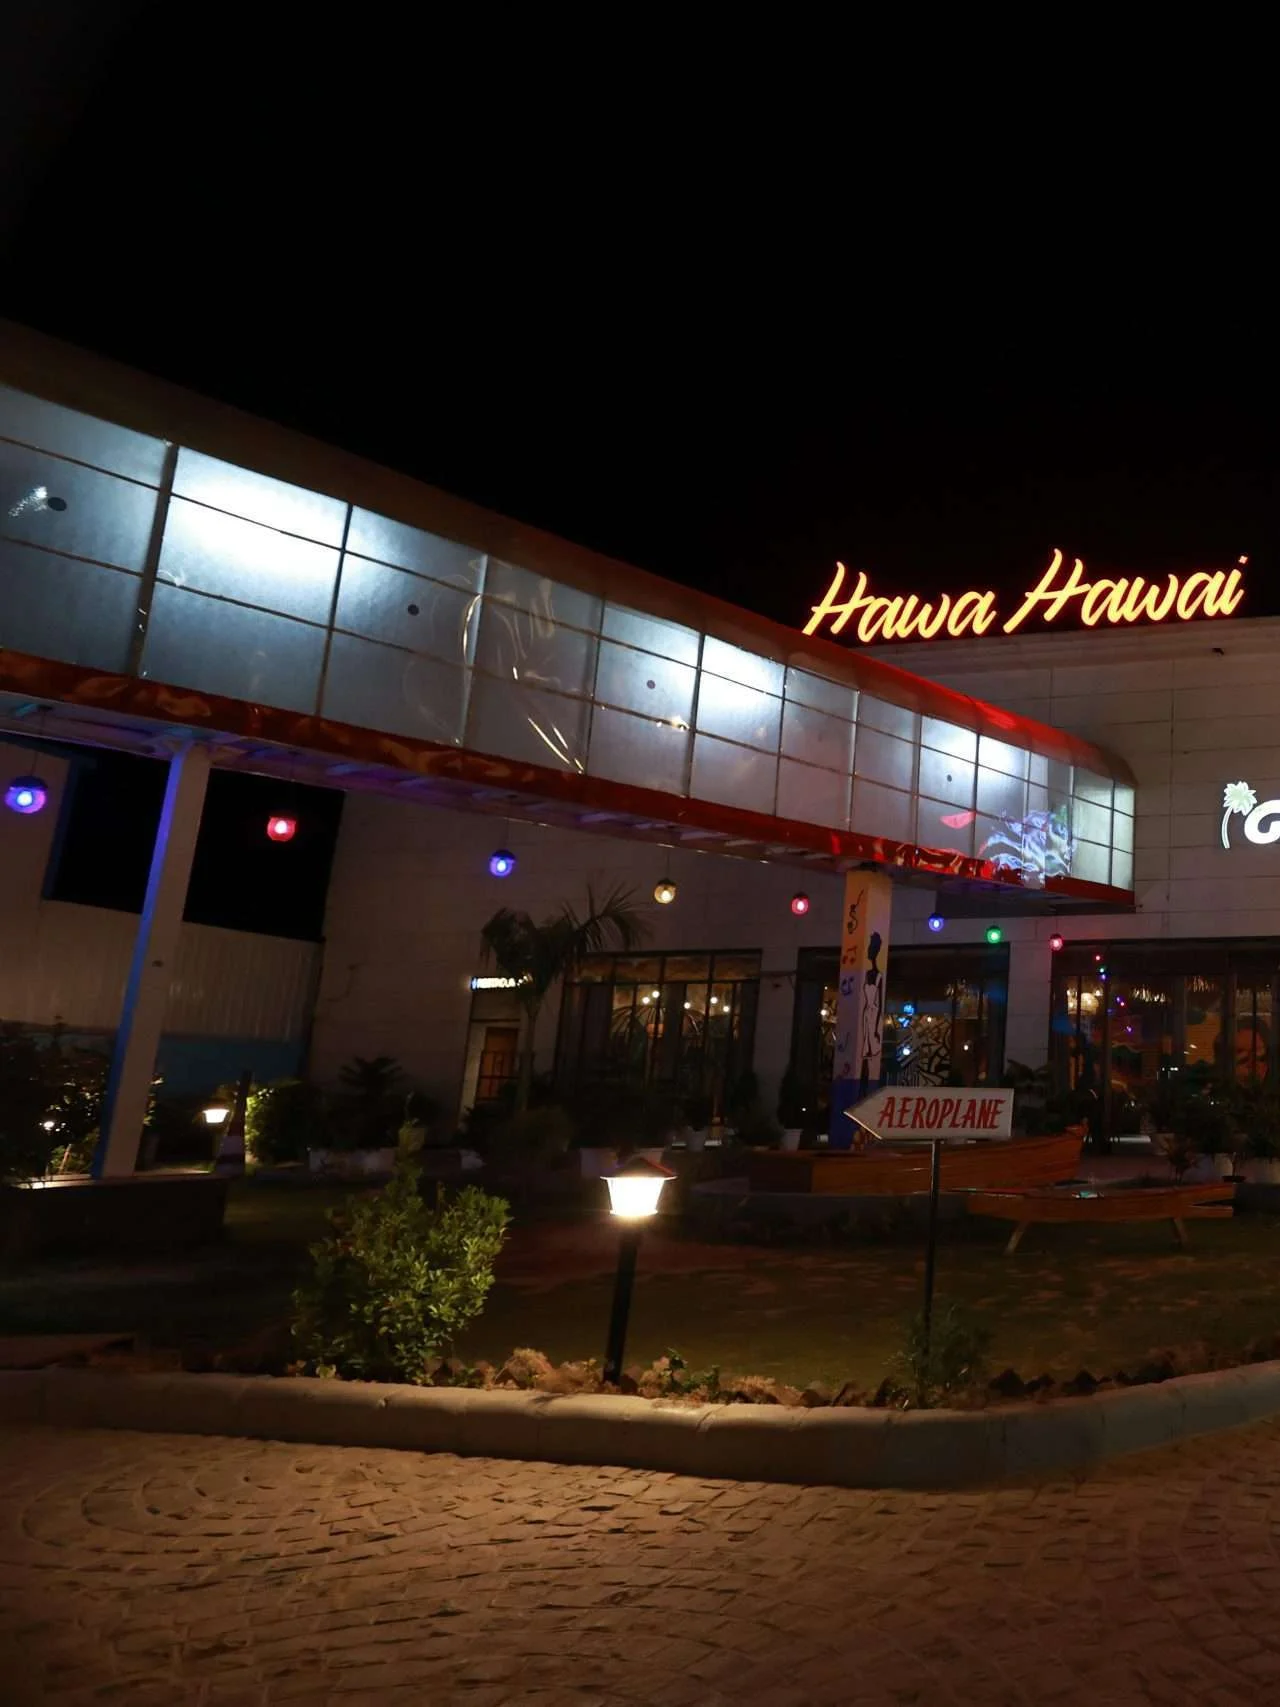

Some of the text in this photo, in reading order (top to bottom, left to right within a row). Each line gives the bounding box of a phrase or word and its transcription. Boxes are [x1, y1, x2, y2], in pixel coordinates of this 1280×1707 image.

[801, 548, 1249, 642] Hawa Hawai
[877, 1096, 1006, 1130] AEROPLANE
